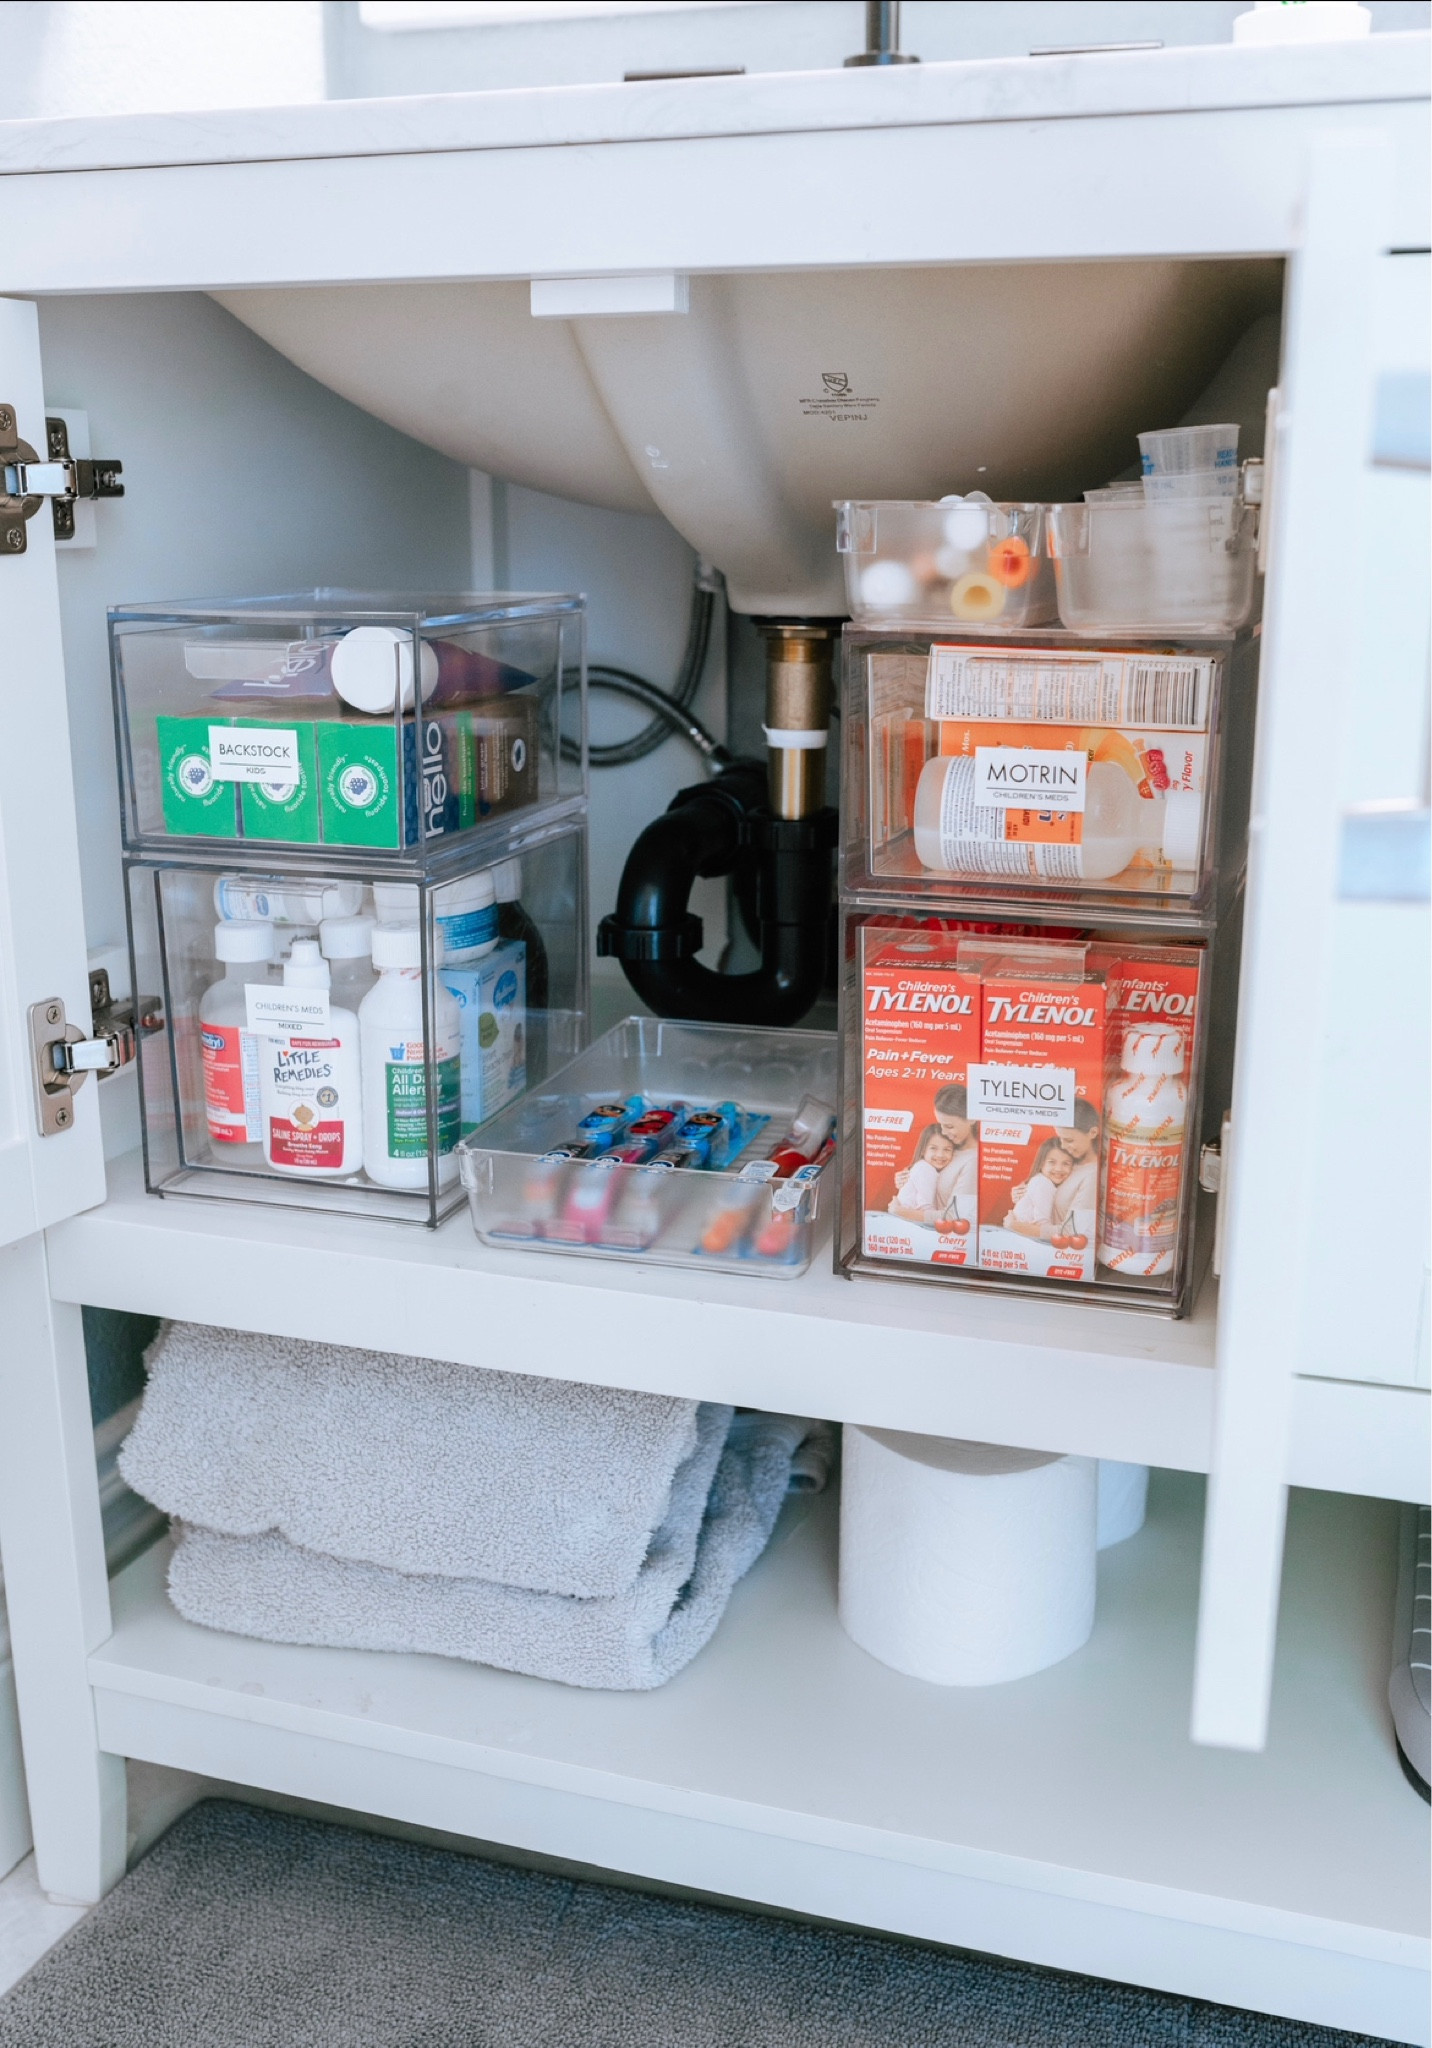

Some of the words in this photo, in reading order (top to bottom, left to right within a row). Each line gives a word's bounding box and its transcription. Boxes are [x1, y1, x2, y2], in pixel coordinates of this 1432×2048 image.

[219, 744, 290, 758] BACKSTOCK
[1182, 751, 1193, 782] Flavor
[364, 755, 389, 793] toothpaste
[423, 722, 447, 838] hello
[987, 763, 1077, 785] MOTRIN
[993, 792, 1042, 800] CHILDREN'S
[898, 980, 956, 992] Children's
[1122, 978, 1168, 992] nfants'
[866, 986, 973, 1014] TYLENOL
[1019, 992, 1080, 1006] Children's
[255, 1002, 300, 1012] CHILDREN'S
[301, 1006, 324, 1014] MEDS
[987, 996, 1096, 1026] TYLENOL
[278, 1022, 302, 1030] MIXED
[865, 1019, 910, 1028] Acetaminophen
[910, 1021, 922, 1029] (160
[985, 1030, 1030, 1039] Acetaminophen
[1031, 1032, 1044, 1041] (160
[1045, 1034, 1055, 1042] mg
[1056, 1034, 1066, 1042] per
[274, 1064, 332, 1083] REMEDIES
[392, 1074, 408, 1084] All
[866, 1066, 898, 1078] Ages
[902, 1067, 926, 1078] 2-11
[931, 1069, 965, 1081] Years
[980, 1079, 1064, 1102] TYLENOL
[986, 1106, 1034, 1115] CHILDREN'S
[1035, 1110, 1058, 1118] MEDS
[868, 1116, 904, 1124] DYE-FREE
[272, 1128, 290, 1140] SALINE
[292, 1131, 312, 1142] SPRAY
[318, 1132, 341, 1143] DROPS
[985, 1128, 1022, 1138] DYE-FREE
[393, 1149, 399, 1157] 4
[1112, 1147, 1179, 1168] TYLENOL
[887, 1236, 898, 1244] (120
[938, 1236, 967, 1246] Cherry
[880, 1246, 888, 1254] mg
[889, 1246, 899, 1254] per
[905, 1247, 914, 1255] mL
[1001, 1251, 1013, 1259] (120
[1055, 1251, 1084, 1262] Cherry
[1020, 1262, 1028, 1270] mL
